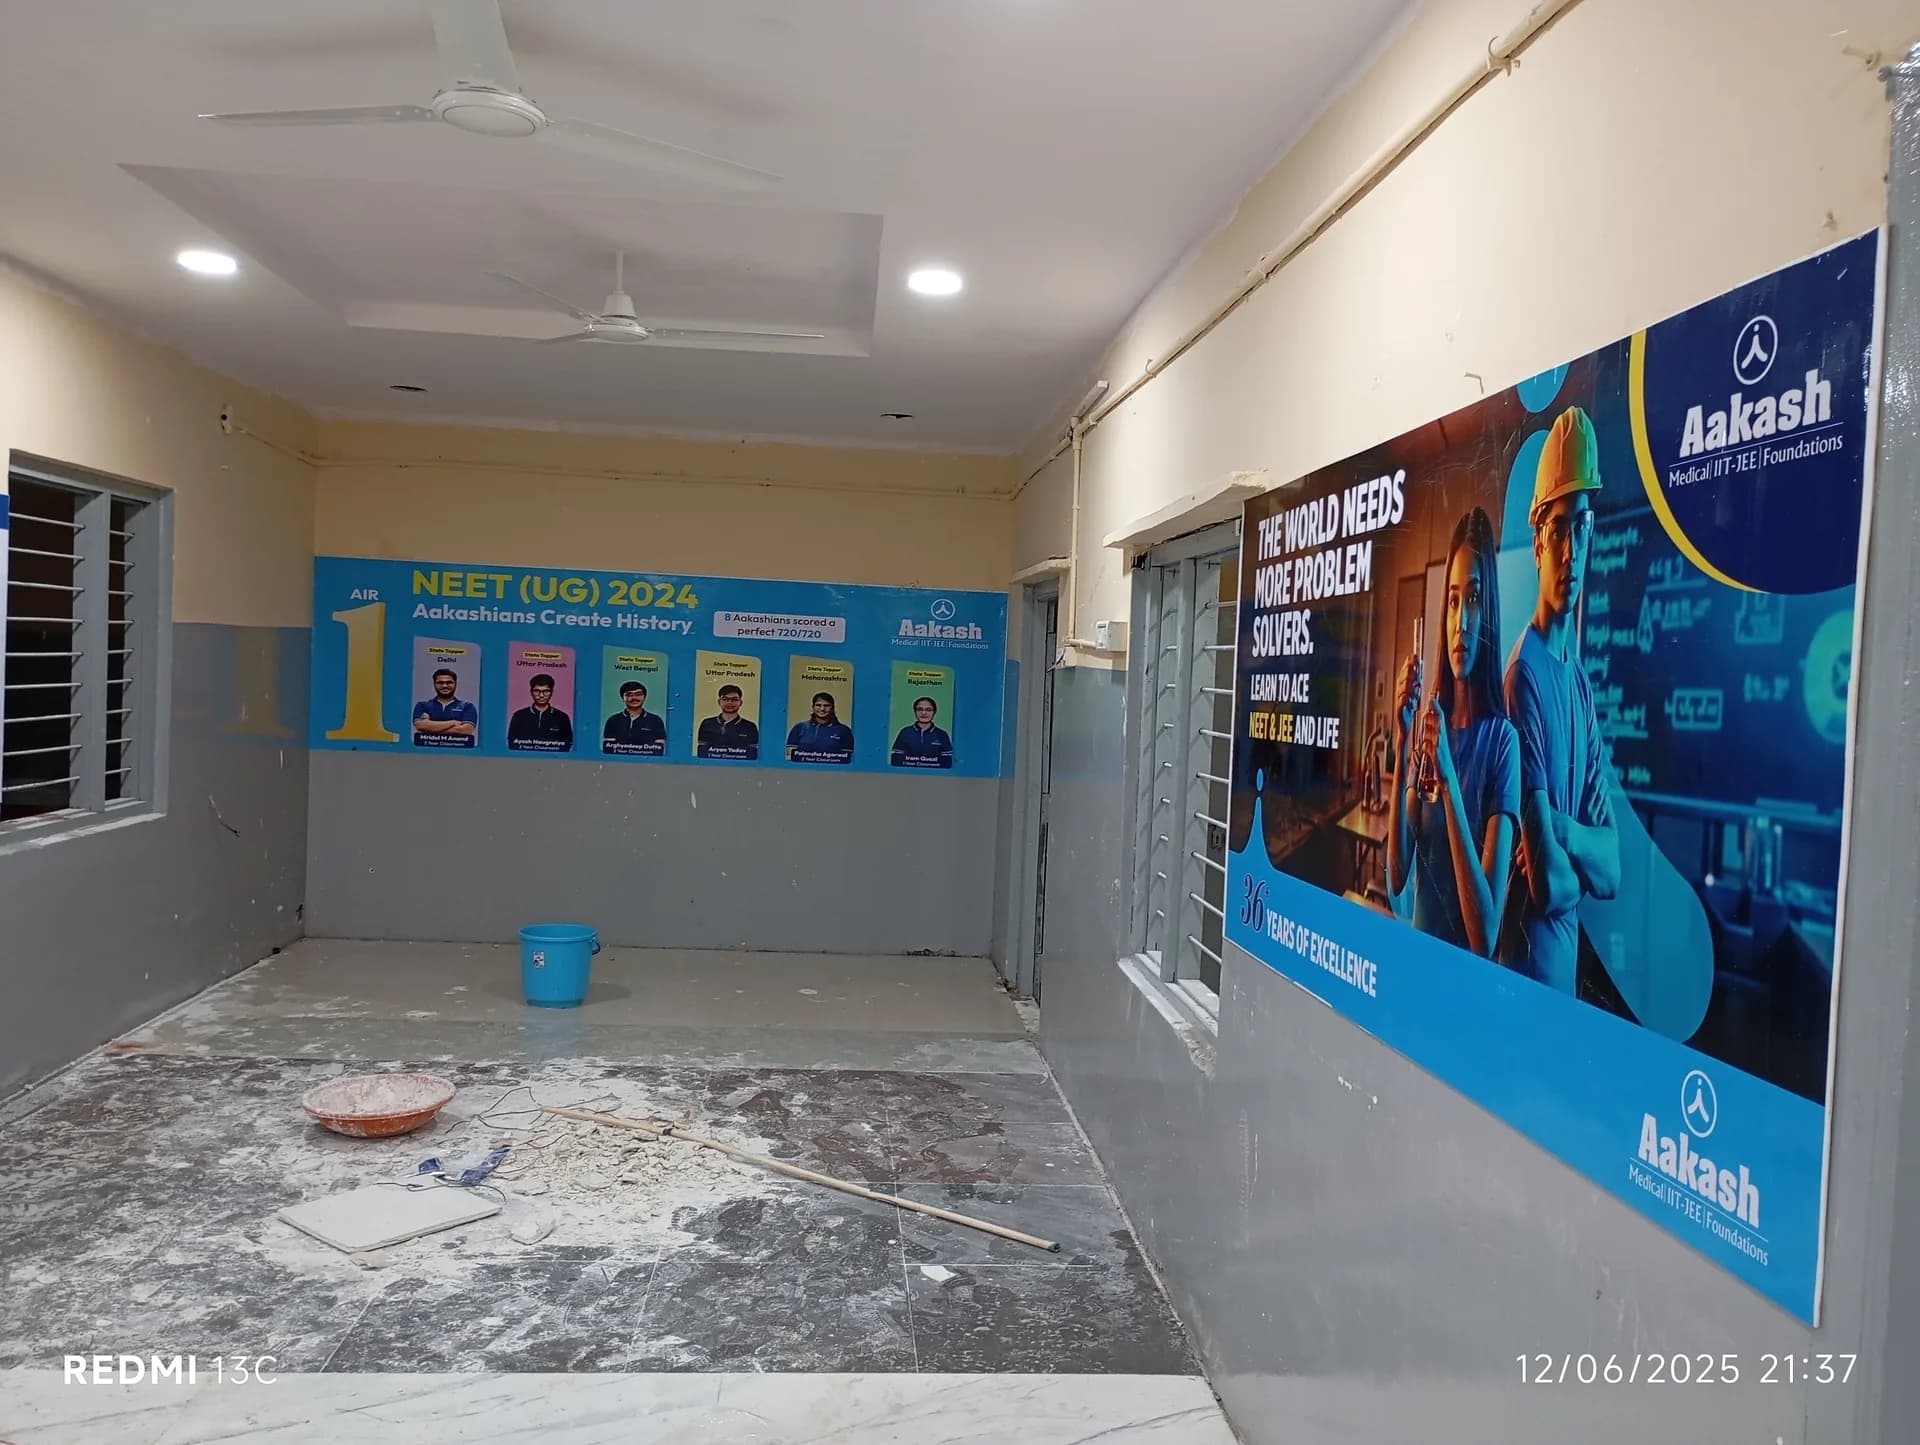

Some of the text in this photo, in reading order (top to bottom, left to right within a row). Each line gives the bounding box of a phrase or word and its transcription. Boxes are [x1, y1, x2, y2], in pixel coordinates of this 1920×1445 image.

[1679, 368, 1832, 458] Aakash
[1258, 469, 1406, 561] THE WORLD NEEDS
[412, 570, 698, 609] NEET (UG) 2024
[1255, 540, 1372, 609] MORE PROBLEM
[350, 588, 379, 600] AIR
[412, 603, 693, 635] Aakashians Create History
[724, 613, 731, 621] 8
[733, 614, 790, 625] Aakashians
[791, 617, 827, 627] scored
[737, 627, 822, 639] perfect 720/720
[899, 619, 982, 640] Aakash
[1252, 609, 1314, 657] SOLVERS.
[325, 602, 400, 742] 1
[802, 674, 847, 682] Maharashtra
[1251, 673, 1310, 703] LEARN TO ACE
[1249, 711, 1340, 749] NEET & JEE AND LIFE
[1267, 908, 1377, 998] YEARS OF EXCELLENCE
[1638, 1112, 1760, 1229] Aakash
